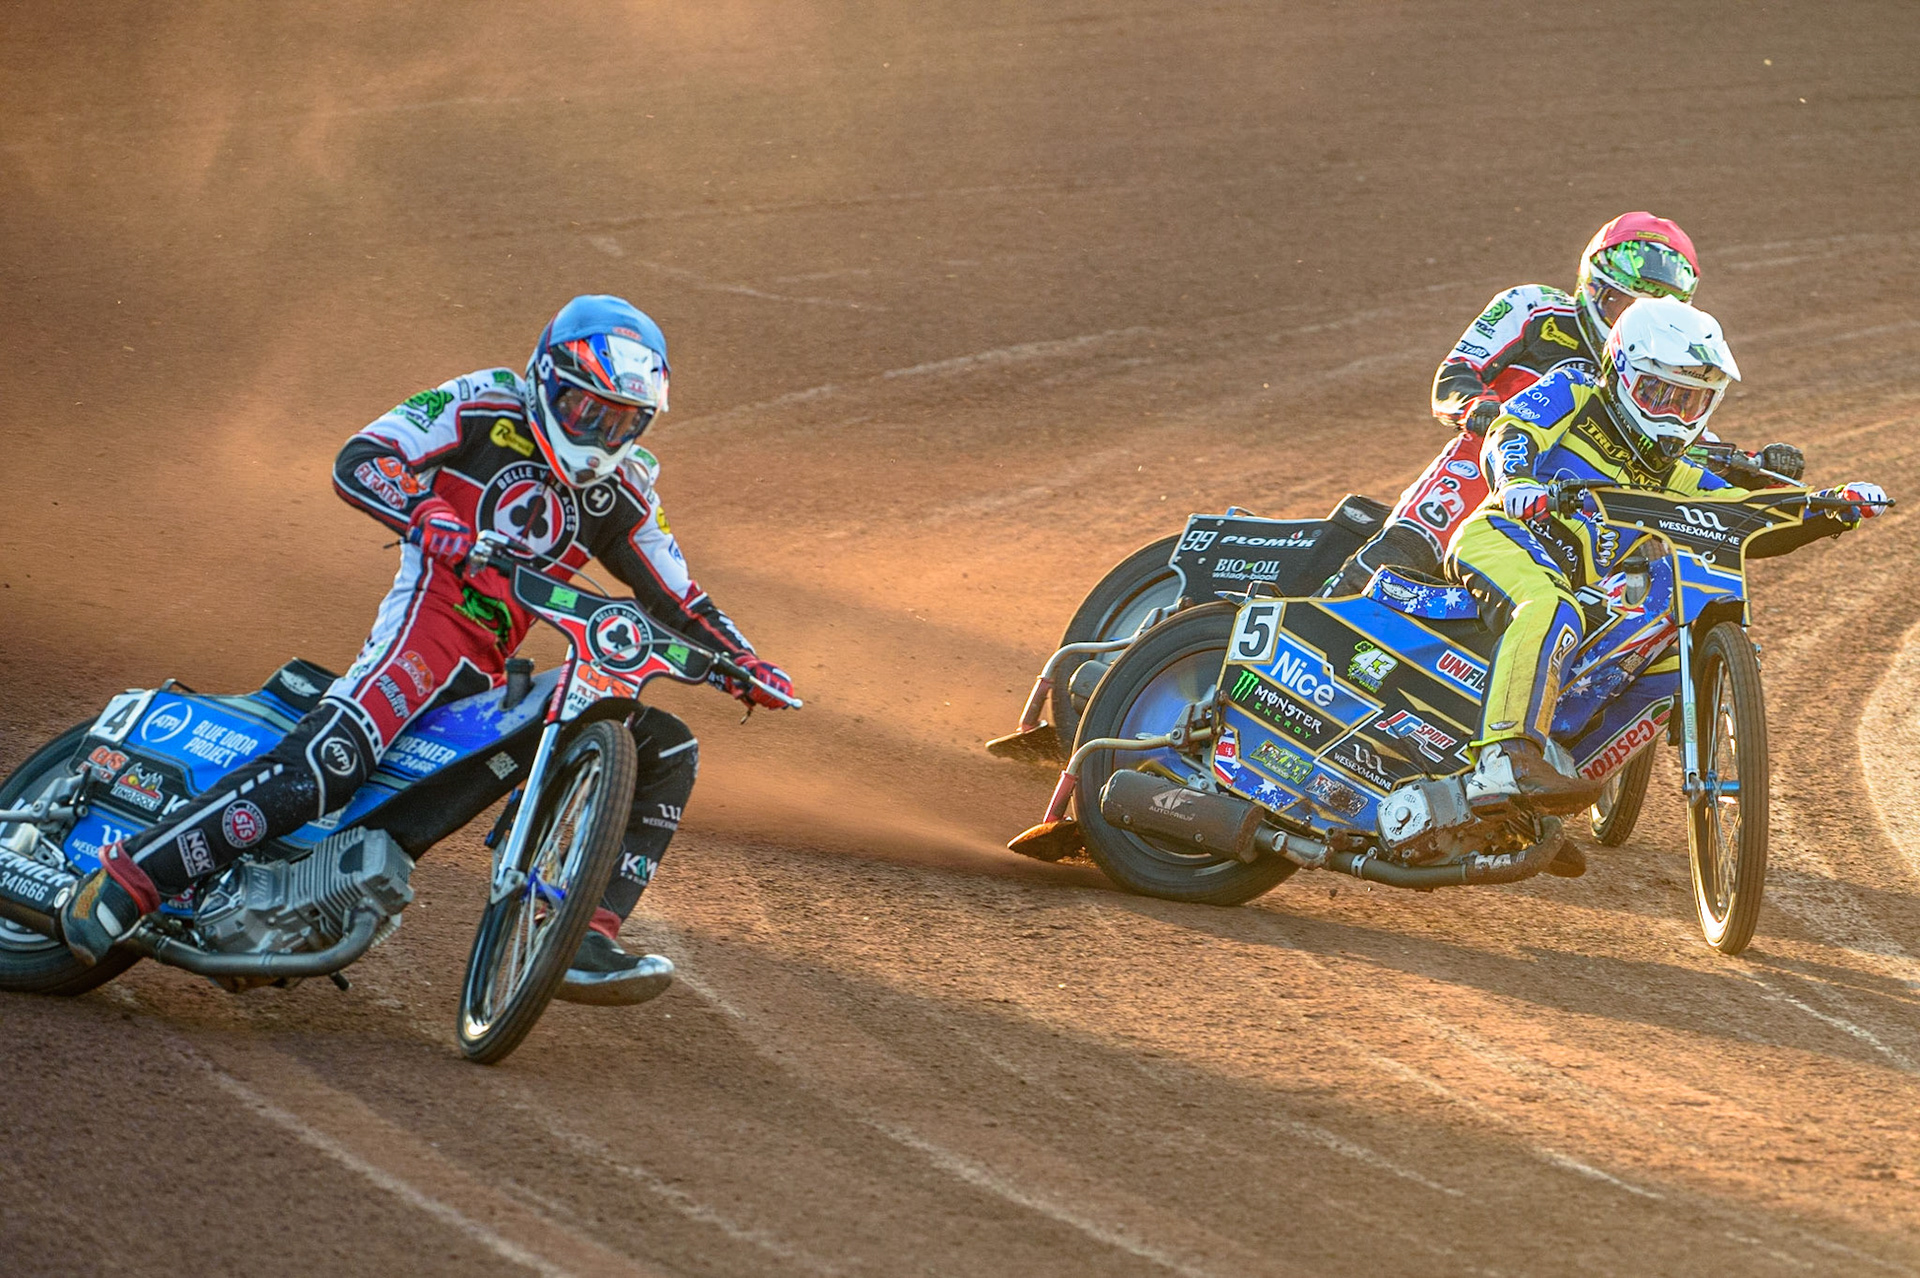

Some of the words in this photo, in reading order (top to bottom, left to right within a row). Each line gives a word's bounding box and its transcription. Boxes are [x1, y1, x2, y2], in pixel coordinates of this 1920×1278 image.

[496, 466, 533, 491] BELLE
[562, 496, 576, 532] ACES
[1180, 530, 1219, 551] 99
[595, 608, 619, 623] BELLE
[1238, 606, 1275, 657] 5
[1270, 650, 1335, 707] Nice
[1352, 649, 1398, 681] 43
[105, 699, 141, 735] 4
[152, 714, 181, 731] ATPI
[1254, 702, 1312, 739] ENERGY
[182, 736, 238, 769] PROJECT
[192, 719, 229, 743] BLUE
[219, 730, 259, 757] DOOR
[1416, 724, 1456, 749] SPORT
[1581, 719, 1656, 781] Castrol
[328, 740, 351, 770] ATPI
[1333, 752, 1393, 791] WESSEXMARINE
[186, 831, 213, 872] NGK
